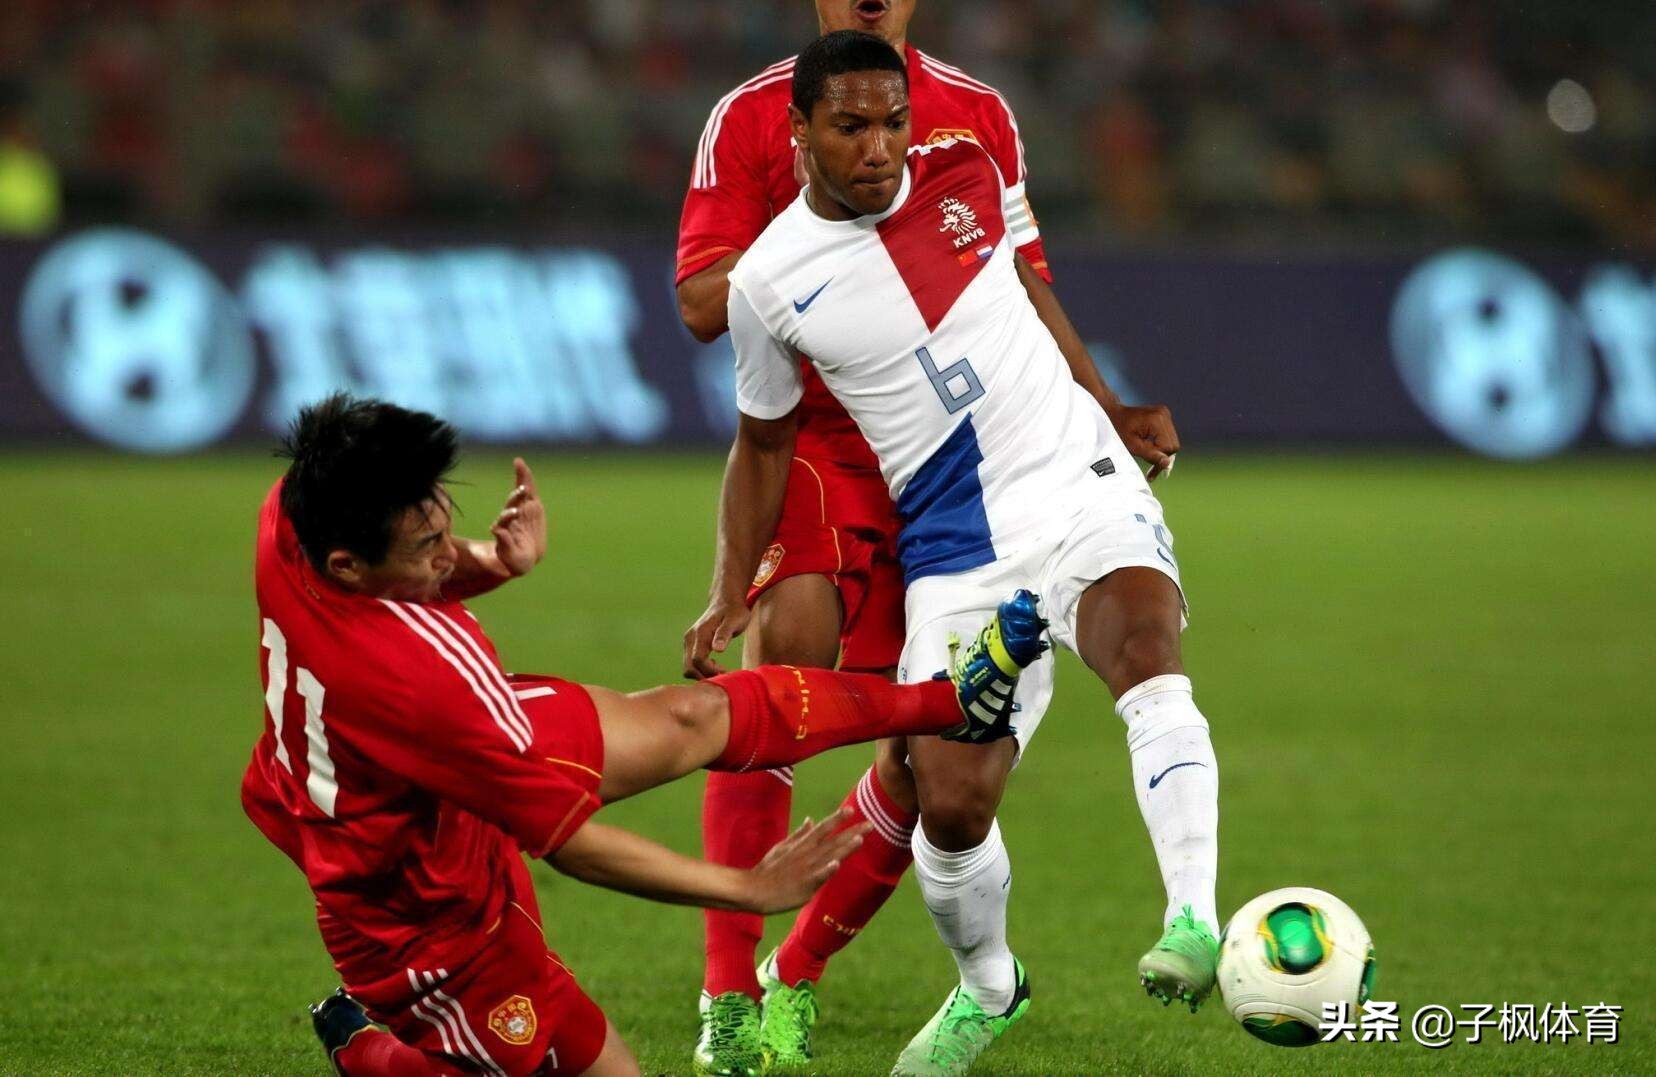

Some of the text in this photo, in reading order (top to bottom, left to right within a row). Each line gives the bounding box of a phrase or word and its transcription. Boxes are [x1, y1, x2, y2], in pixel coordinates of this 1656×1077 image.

[953, 227, 986, 249] KNVB
[915, 346, 986, 415] 6
[261, 617, 339, 819] 11
